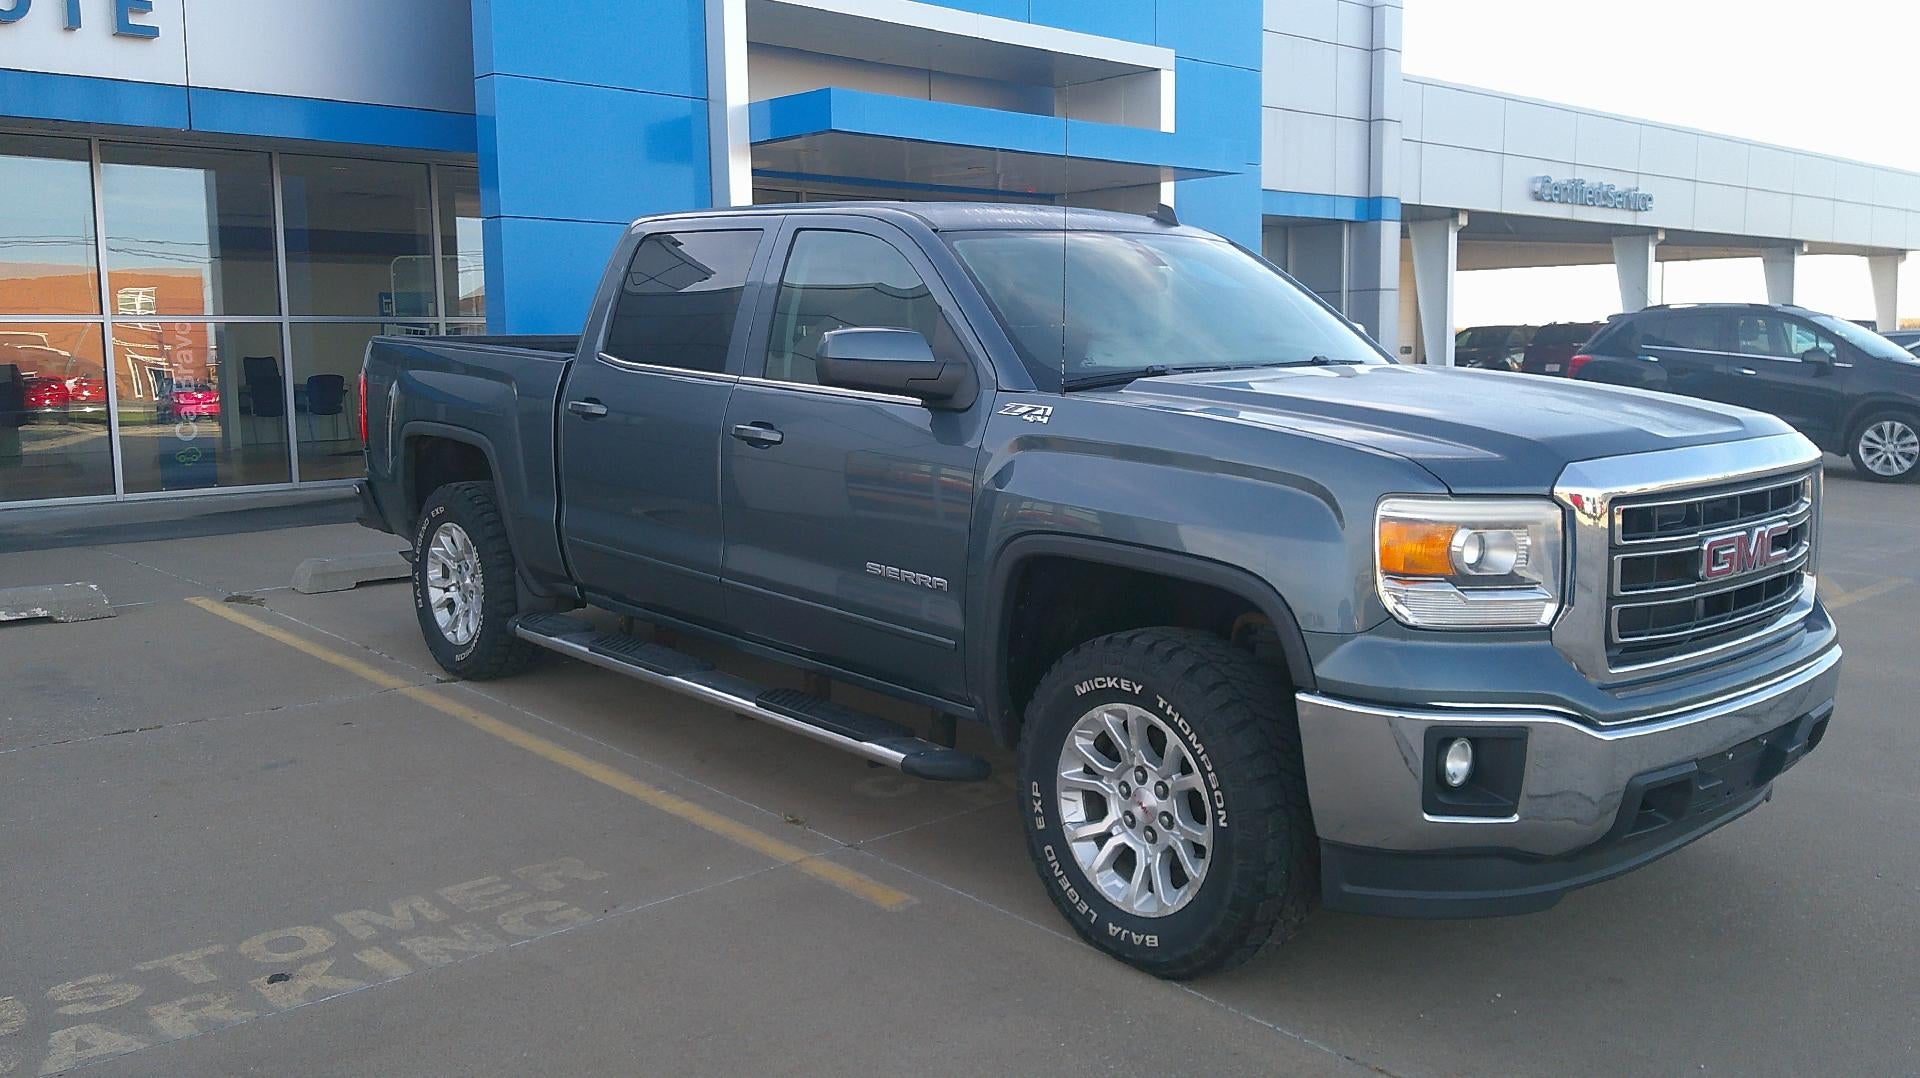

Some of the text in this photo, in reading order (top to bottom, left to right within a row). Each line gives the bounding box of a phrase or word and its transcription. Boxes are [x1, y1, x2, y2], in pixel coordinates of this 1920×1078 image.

[1531, 175, 1654, 211] Certified Service
[997, 402, 1054, 417] Z71
[431, 506, 445, 518] EXP
[1702, 521, 1789, 580] GMC
[865, 561, 948, 592] SIERRA
[1073, 676, 1229, 828] MICKEY THOMPSON
[1031, 781, 1159, 947] BAJA LEGEND EXP
[0, 900, 594, 1078] ARKING
